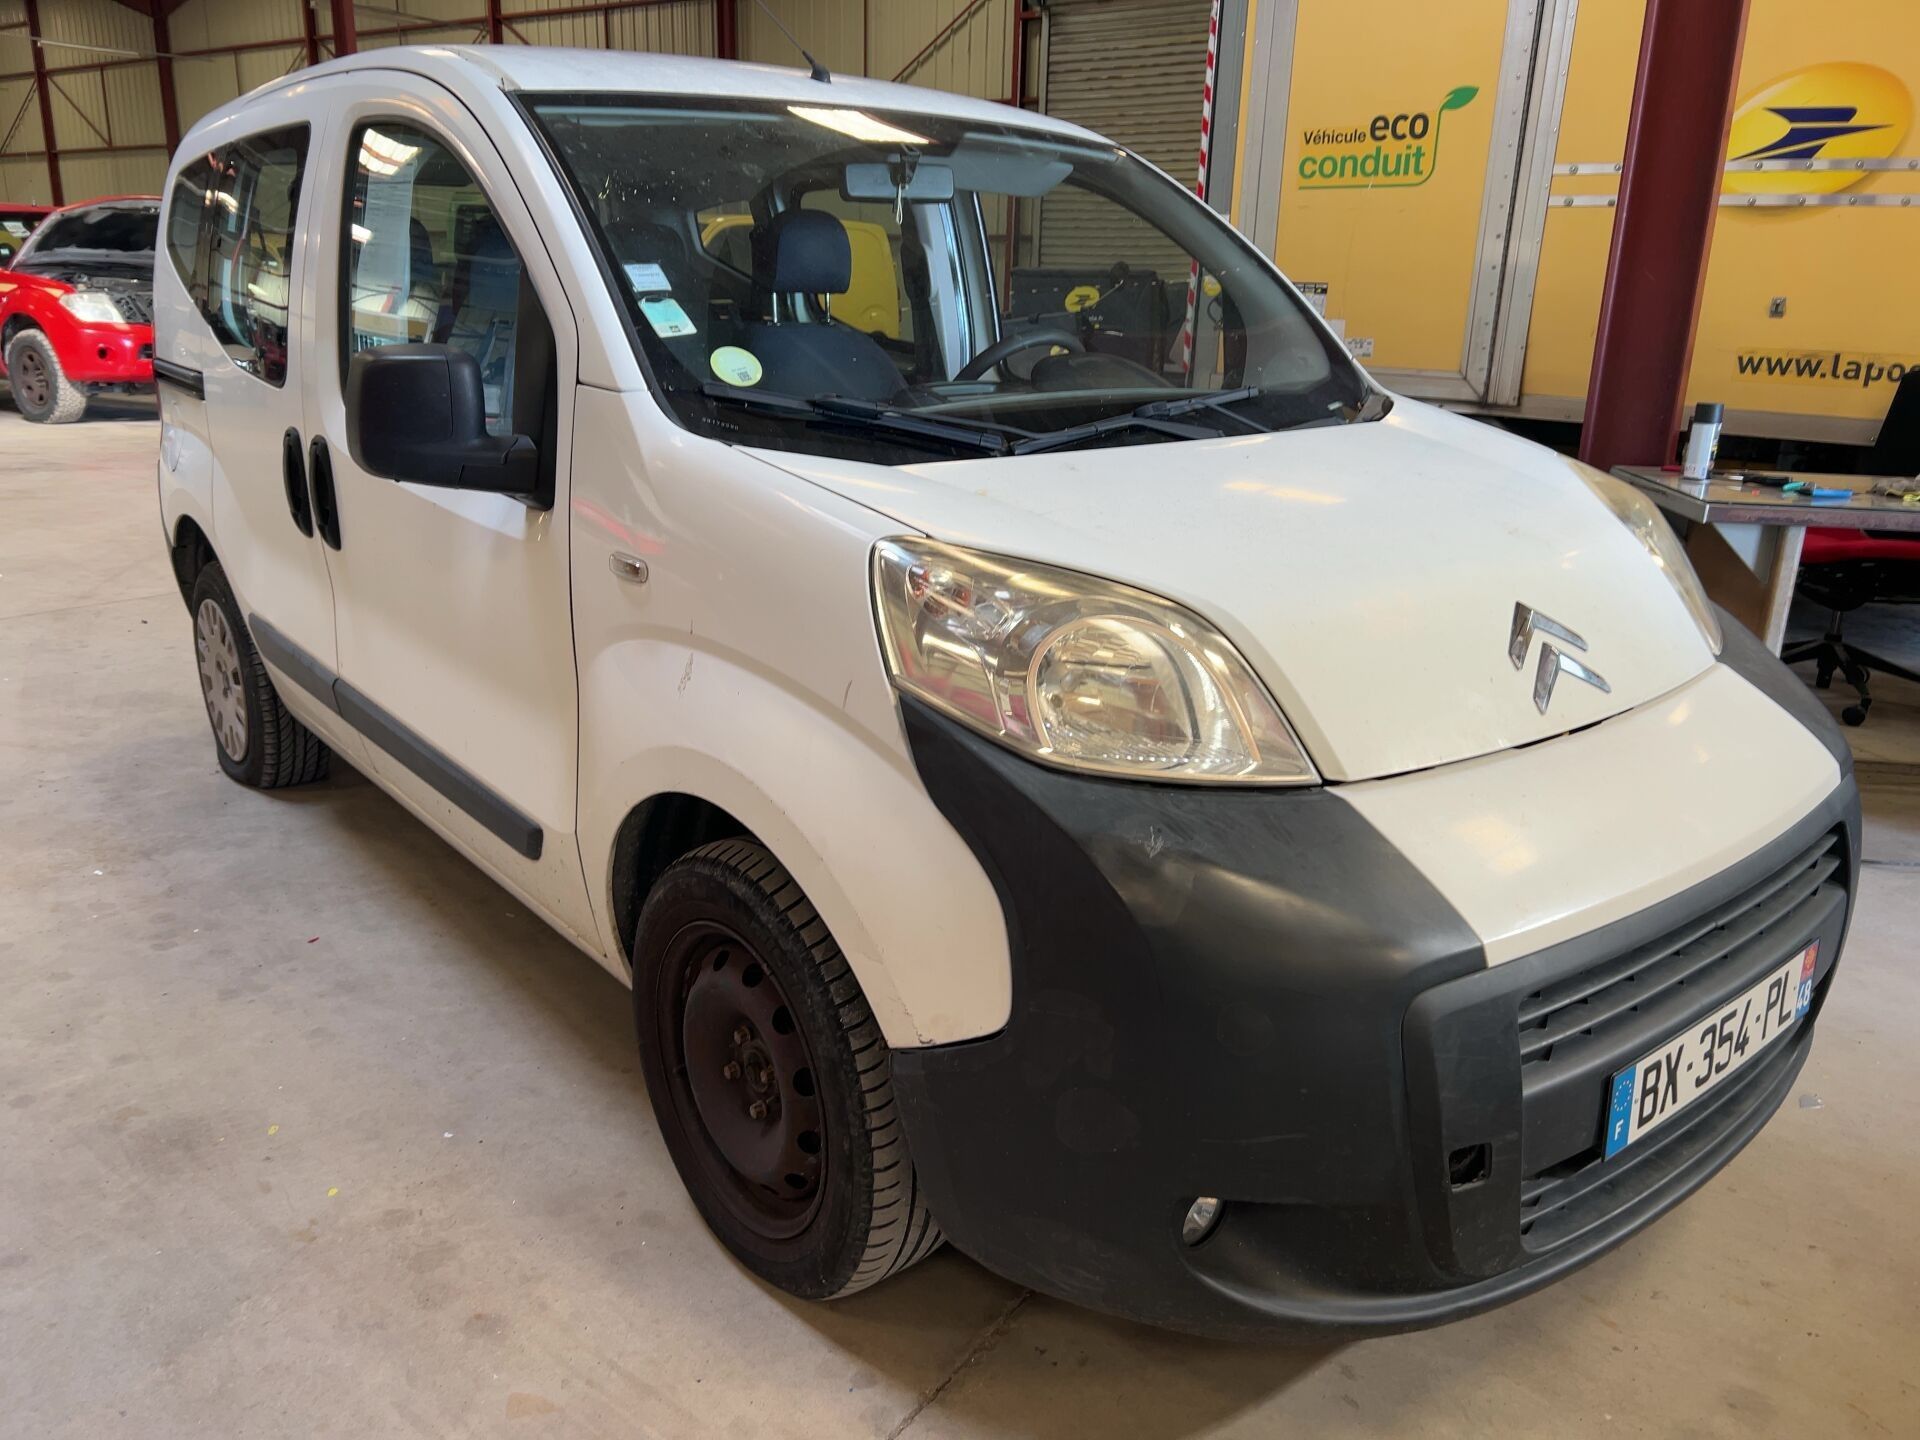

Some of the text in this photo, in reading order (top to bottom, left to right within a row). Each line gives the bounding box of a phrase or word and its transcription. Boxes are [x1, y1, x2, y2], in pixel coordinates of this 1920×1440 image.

[1304, 112, 1430, 145] Véhicule eco
[1298, 145, 1425, 180] conduit
[1796, 979, 1812, 1011] 48
[1614, 1119, 1624, 1141] F
